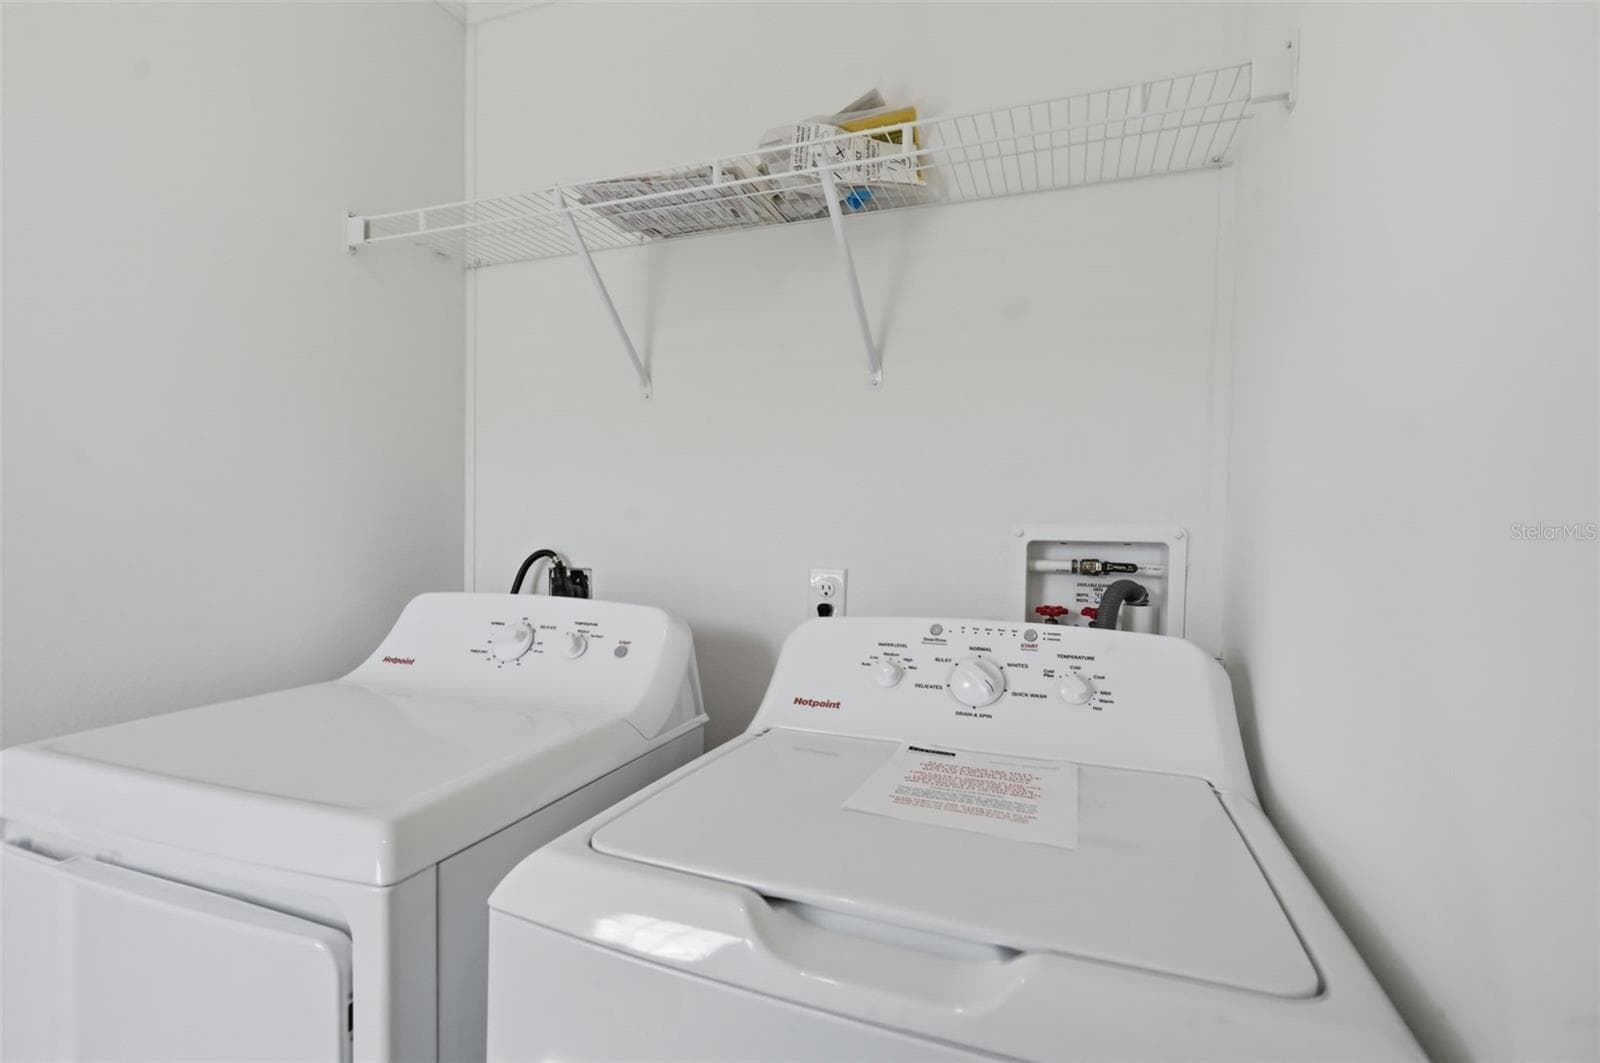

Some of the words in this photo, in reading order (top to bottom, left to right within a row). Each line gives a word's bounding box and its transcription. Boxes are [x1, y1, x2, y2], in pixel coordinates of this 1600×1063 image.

[382, 656, 415, 665] Hotpoint
[1057, 653, 1095, 661] TEMPERATURE
[793, 697, 841, 709] Hotpoint
